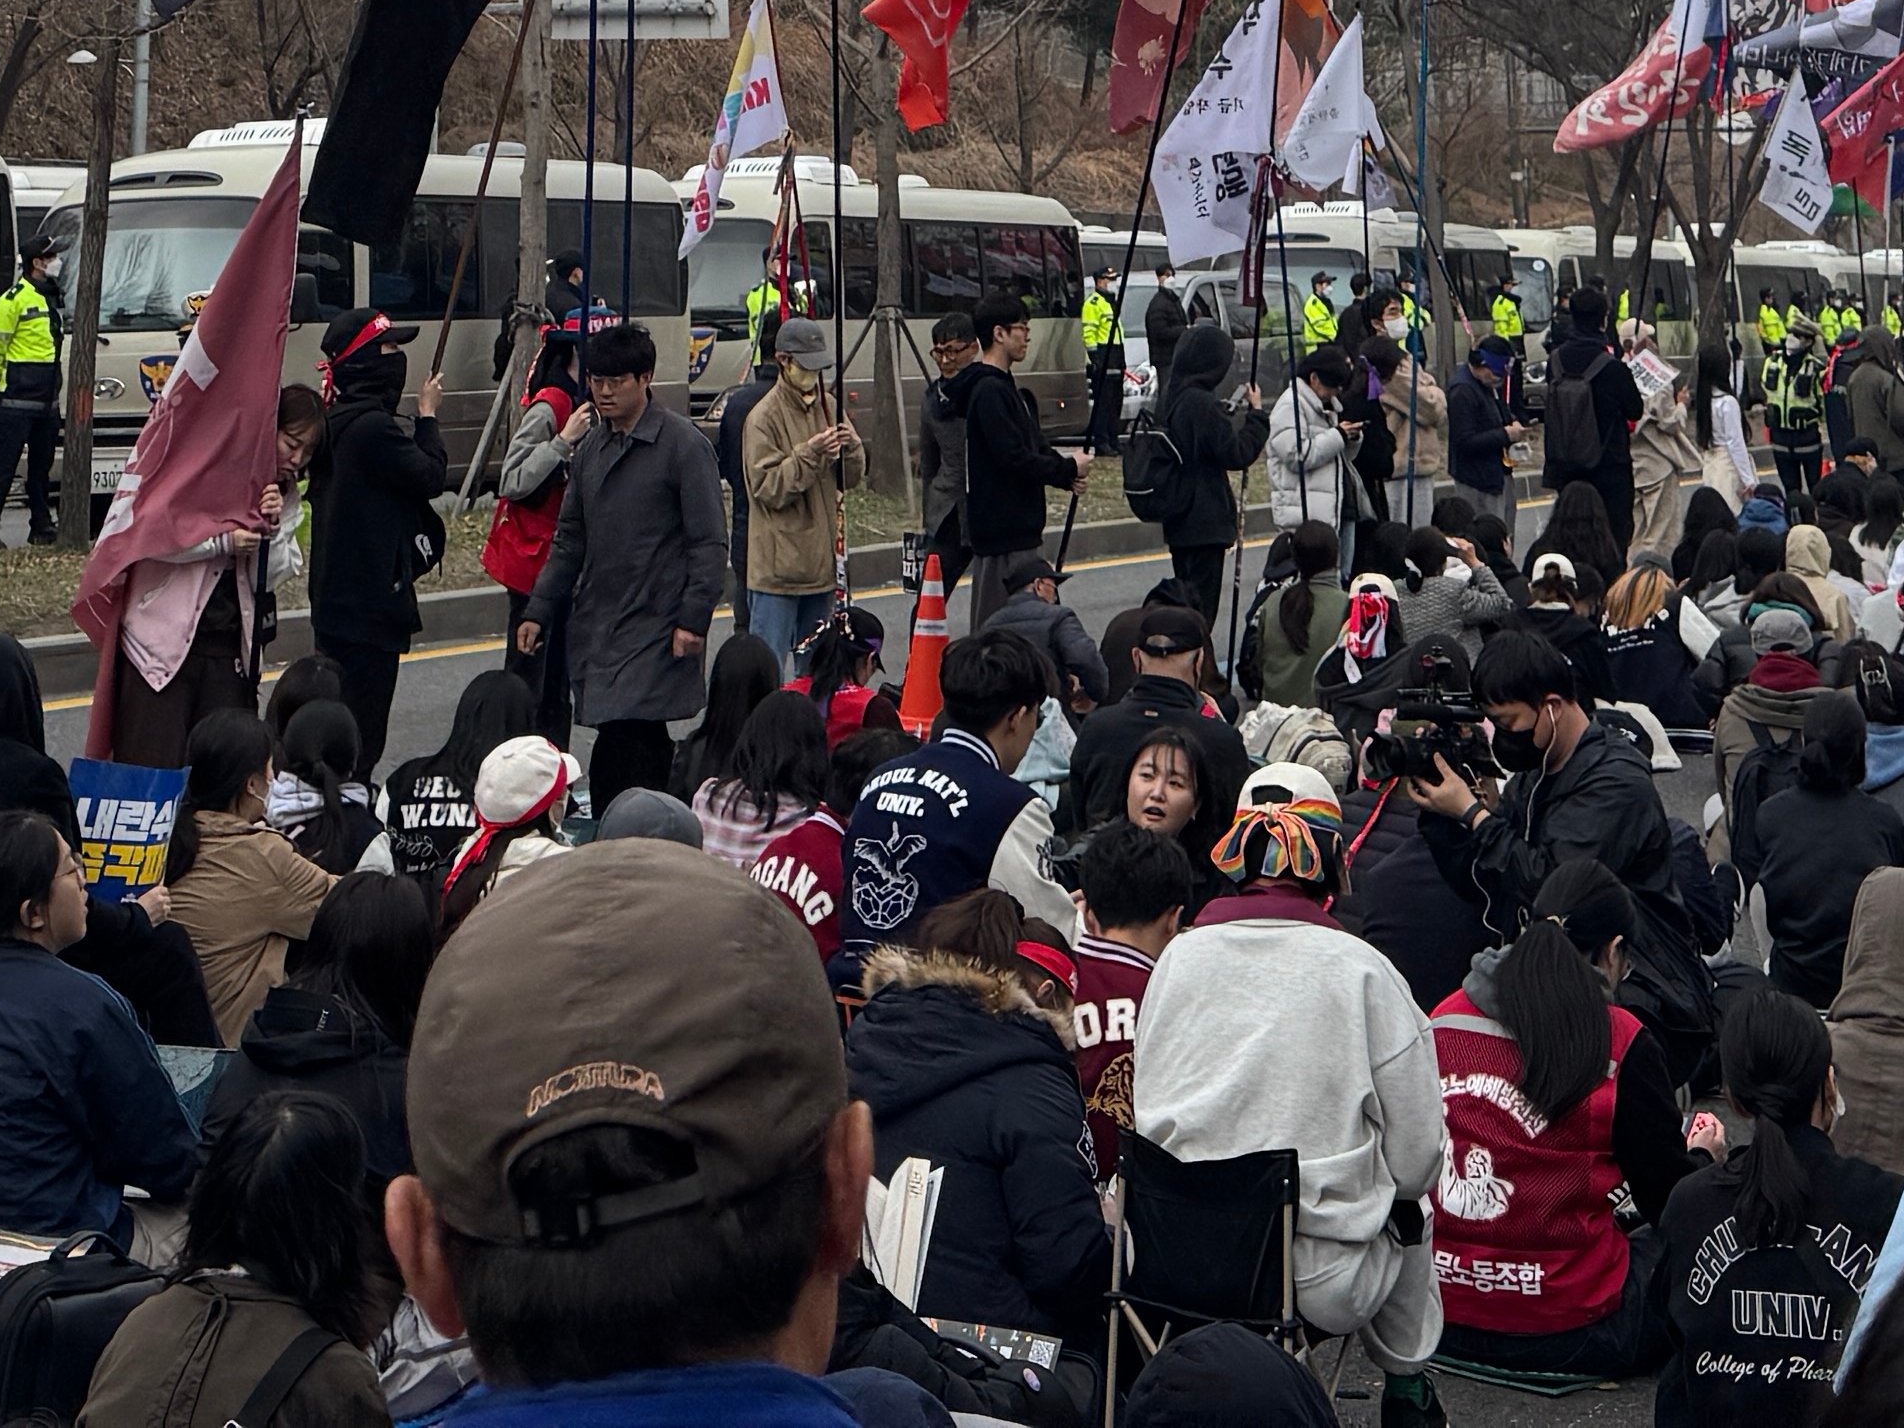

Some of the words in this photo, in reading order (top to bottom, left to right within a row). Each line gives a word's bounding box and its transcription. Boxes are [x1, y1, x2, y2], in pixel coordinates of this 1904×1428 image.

[1731, 1289, 1843, 1343] UNIV.
[1696, 1350, 1757, 1385] College
[1761, 1356, 1783, 1385] of
